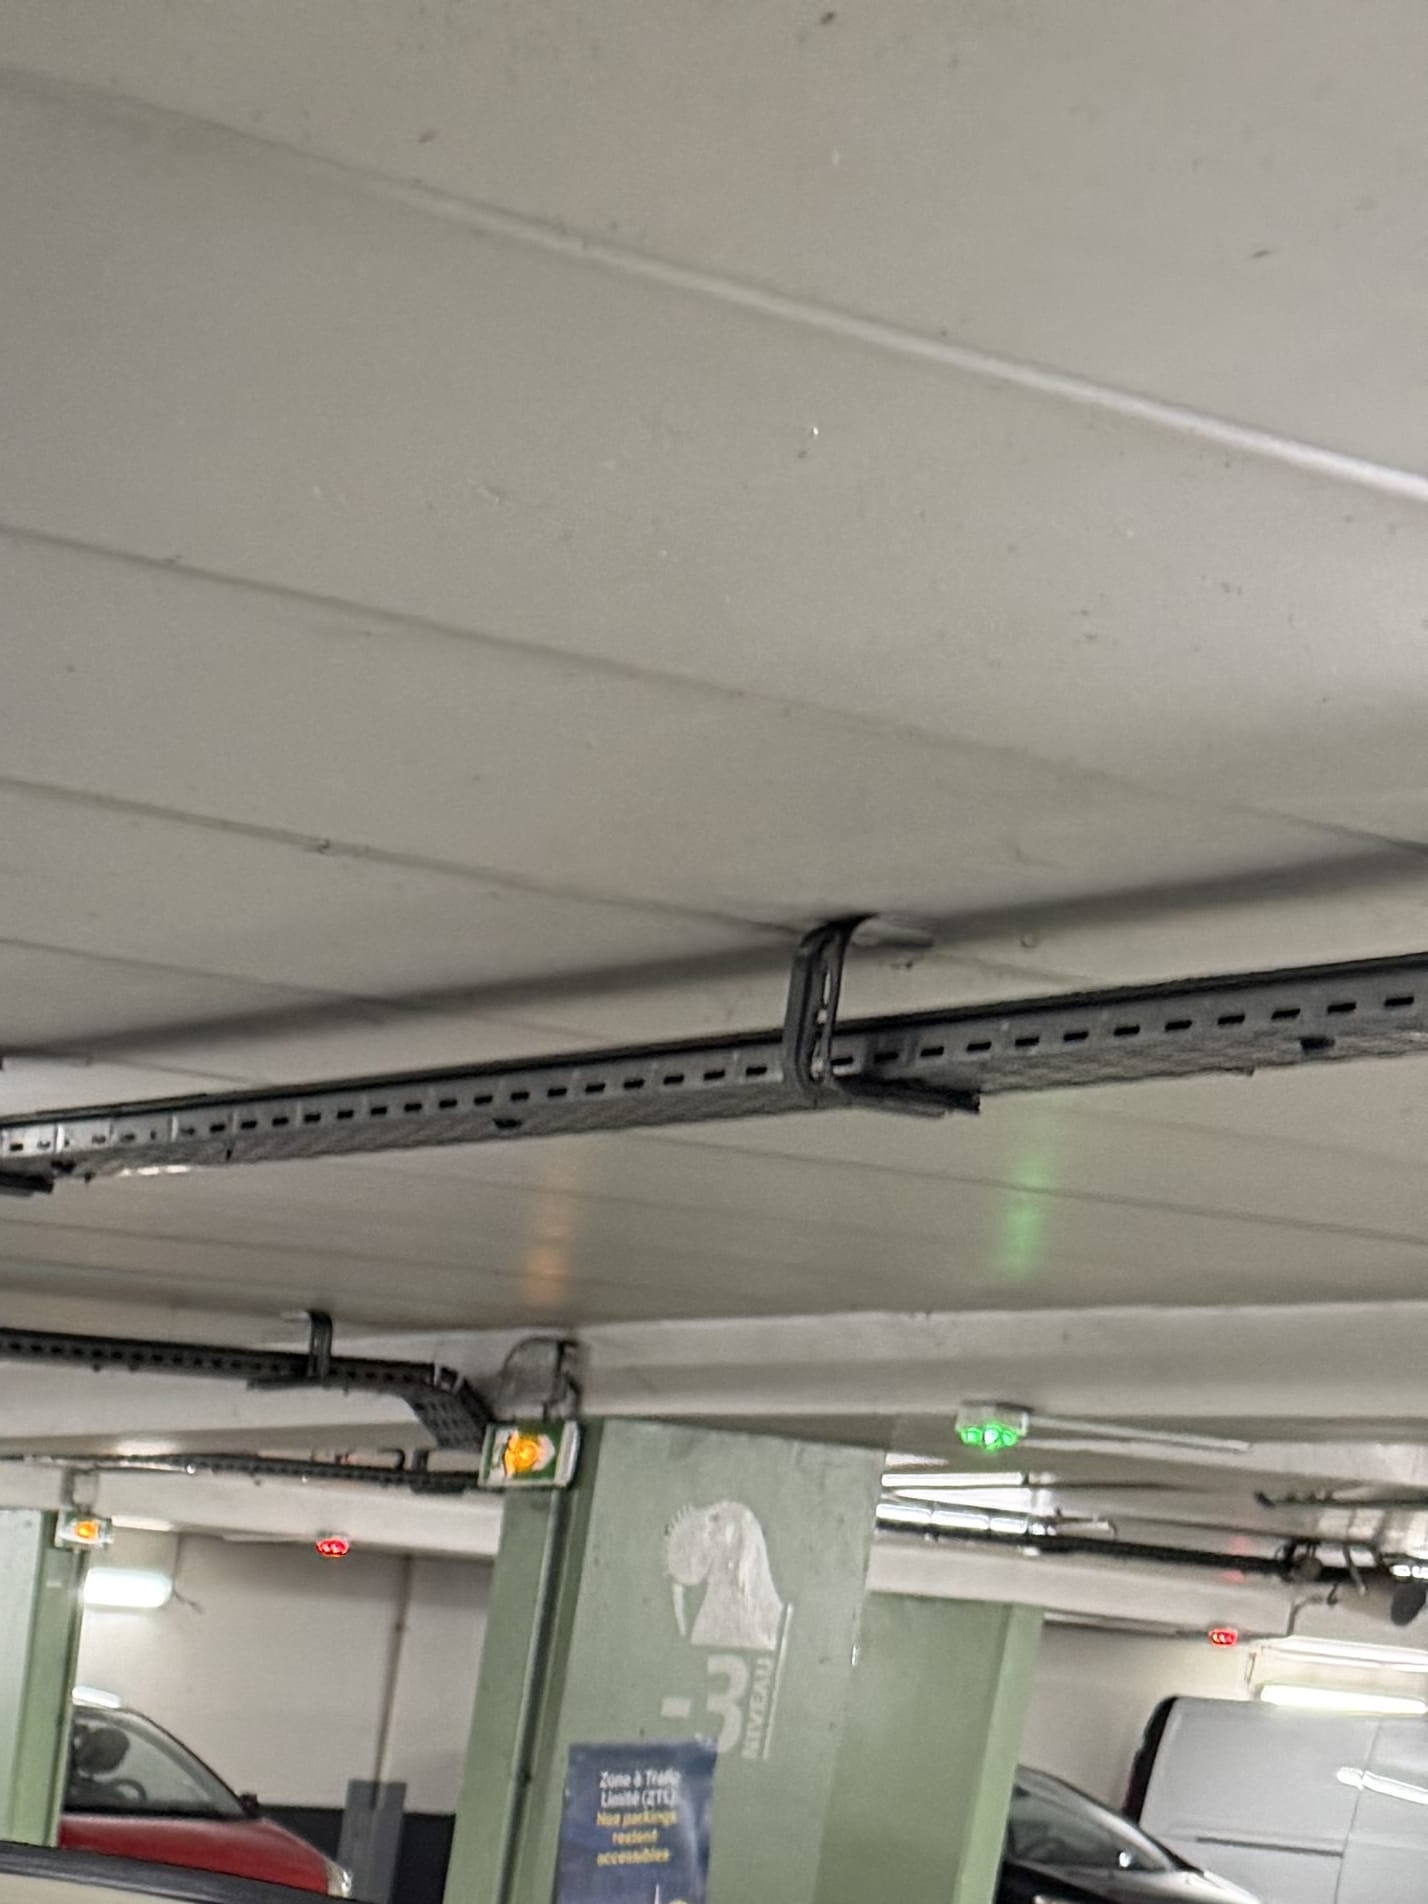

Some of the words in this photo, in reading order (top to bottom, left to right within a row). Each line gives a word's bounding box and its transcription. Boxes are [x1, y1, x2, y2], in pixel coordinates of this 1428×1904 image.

[660, 1654, 749, 1754] -3
[741, 1657, 776, 1760] NIVEAU
[600, 1770, 632, 1789] Zone
